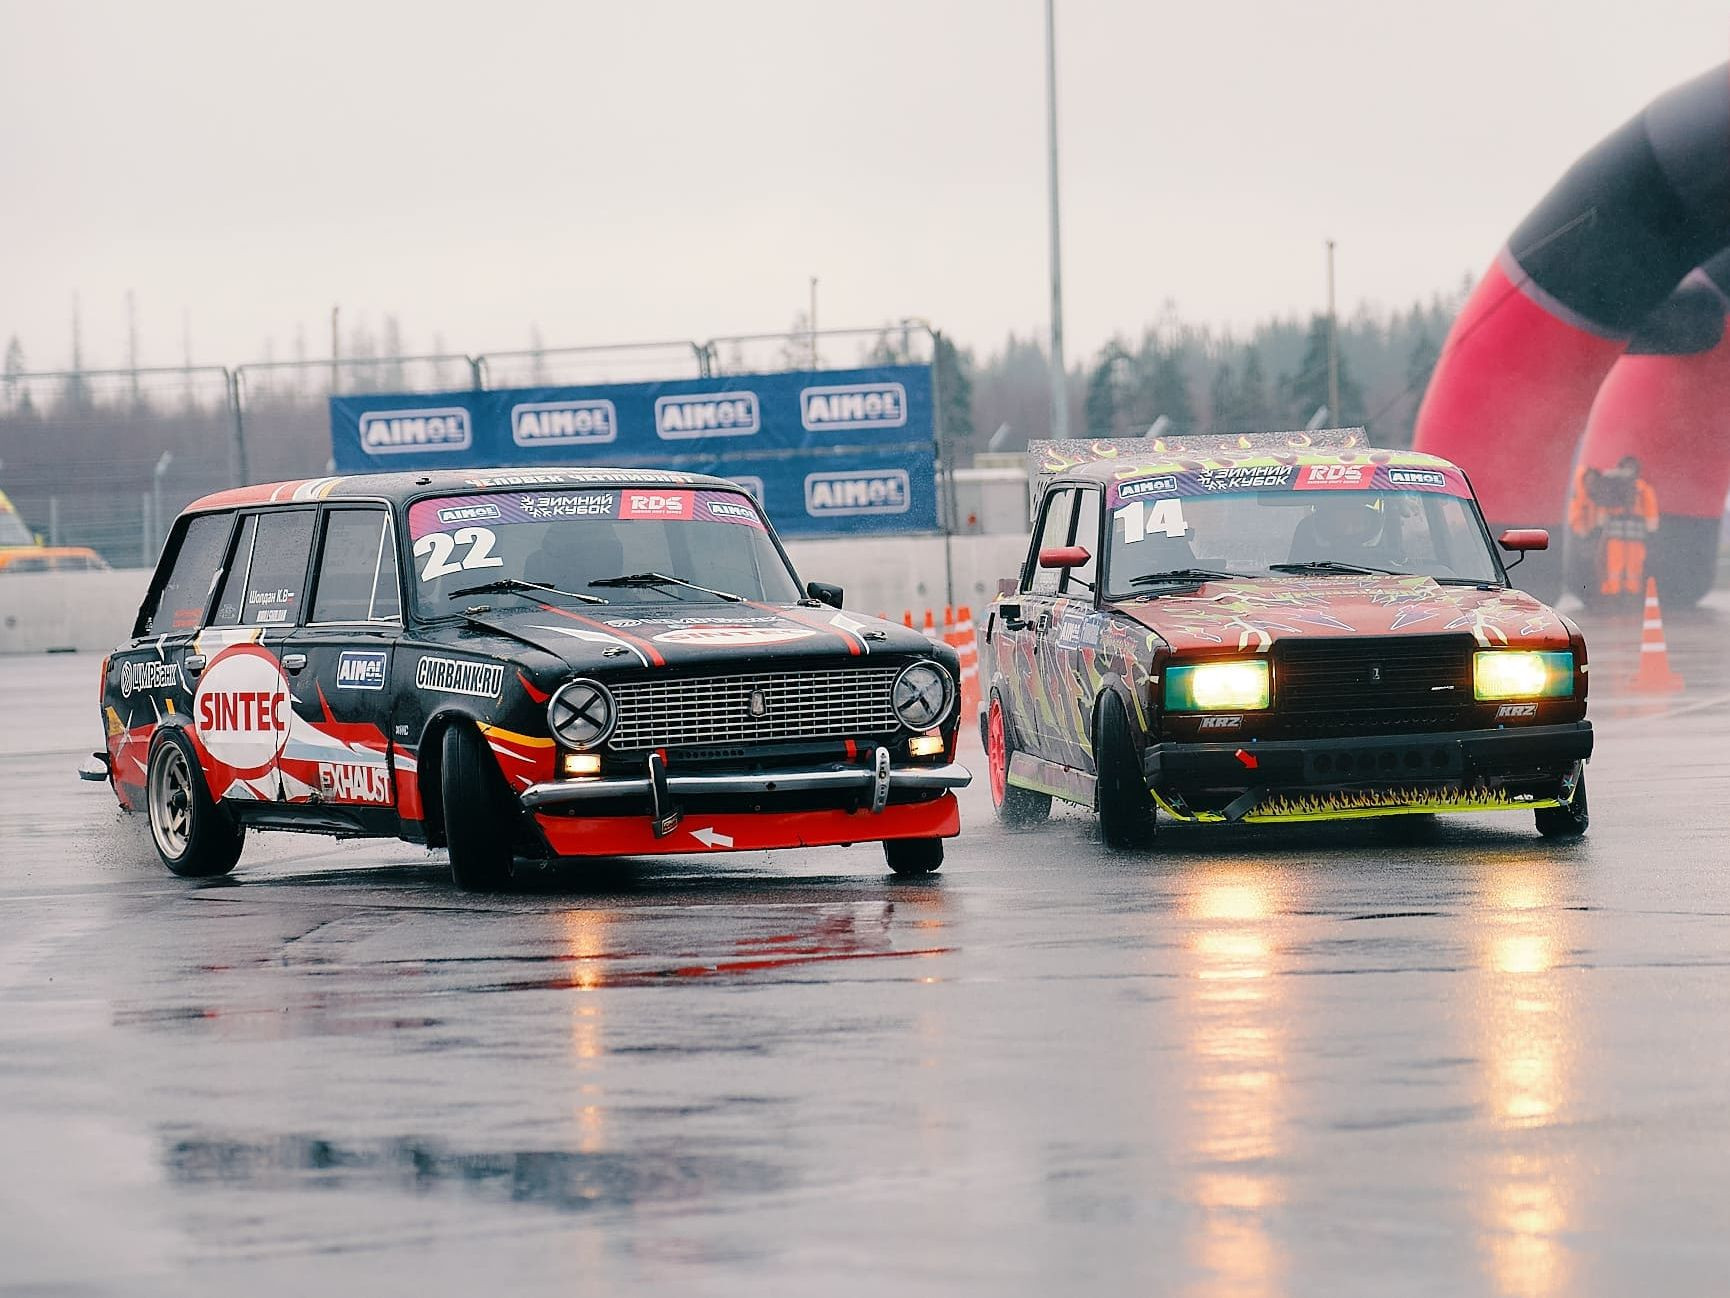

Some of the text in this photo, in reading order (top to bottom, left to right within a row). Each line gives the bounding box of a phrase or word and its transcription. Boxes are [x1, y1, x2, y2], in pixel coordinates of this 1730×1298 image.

[661, 400, 753, 431] AIMOL
[807, 391, 899, 422] AIMOL
[366, 415, 464, 446] AIMOL
[518, 407, 610, 438] AIMOL
[1229, 476, 1288, 488] КУБОК
[1309, 465, 1363, 480] RDS
[1392, 473, 1442, 485] AIMOL
[537, 494, 613, 506] ЗИМНИЙ
[811, 477, 904, 508] AIMOL
[1120, 478, 1174, 497] AIMOL
[442, 507, 498, 522] AIMOL
[553, 505, 612, 516] КУБОК
[631, 496, 682, 510] RDS
[1114, 499, 1188, 544] 14
[413, 527, 503, 582] 22
[132, 661, 177, 692] ЦМРБанк
[339, 660, 383, 682] AIMOL
[200, 693, 285, 731] SINTEC
[1499, 705, 1536, 717] KRZ
[318, 762, 391, 804] EXHAUST
